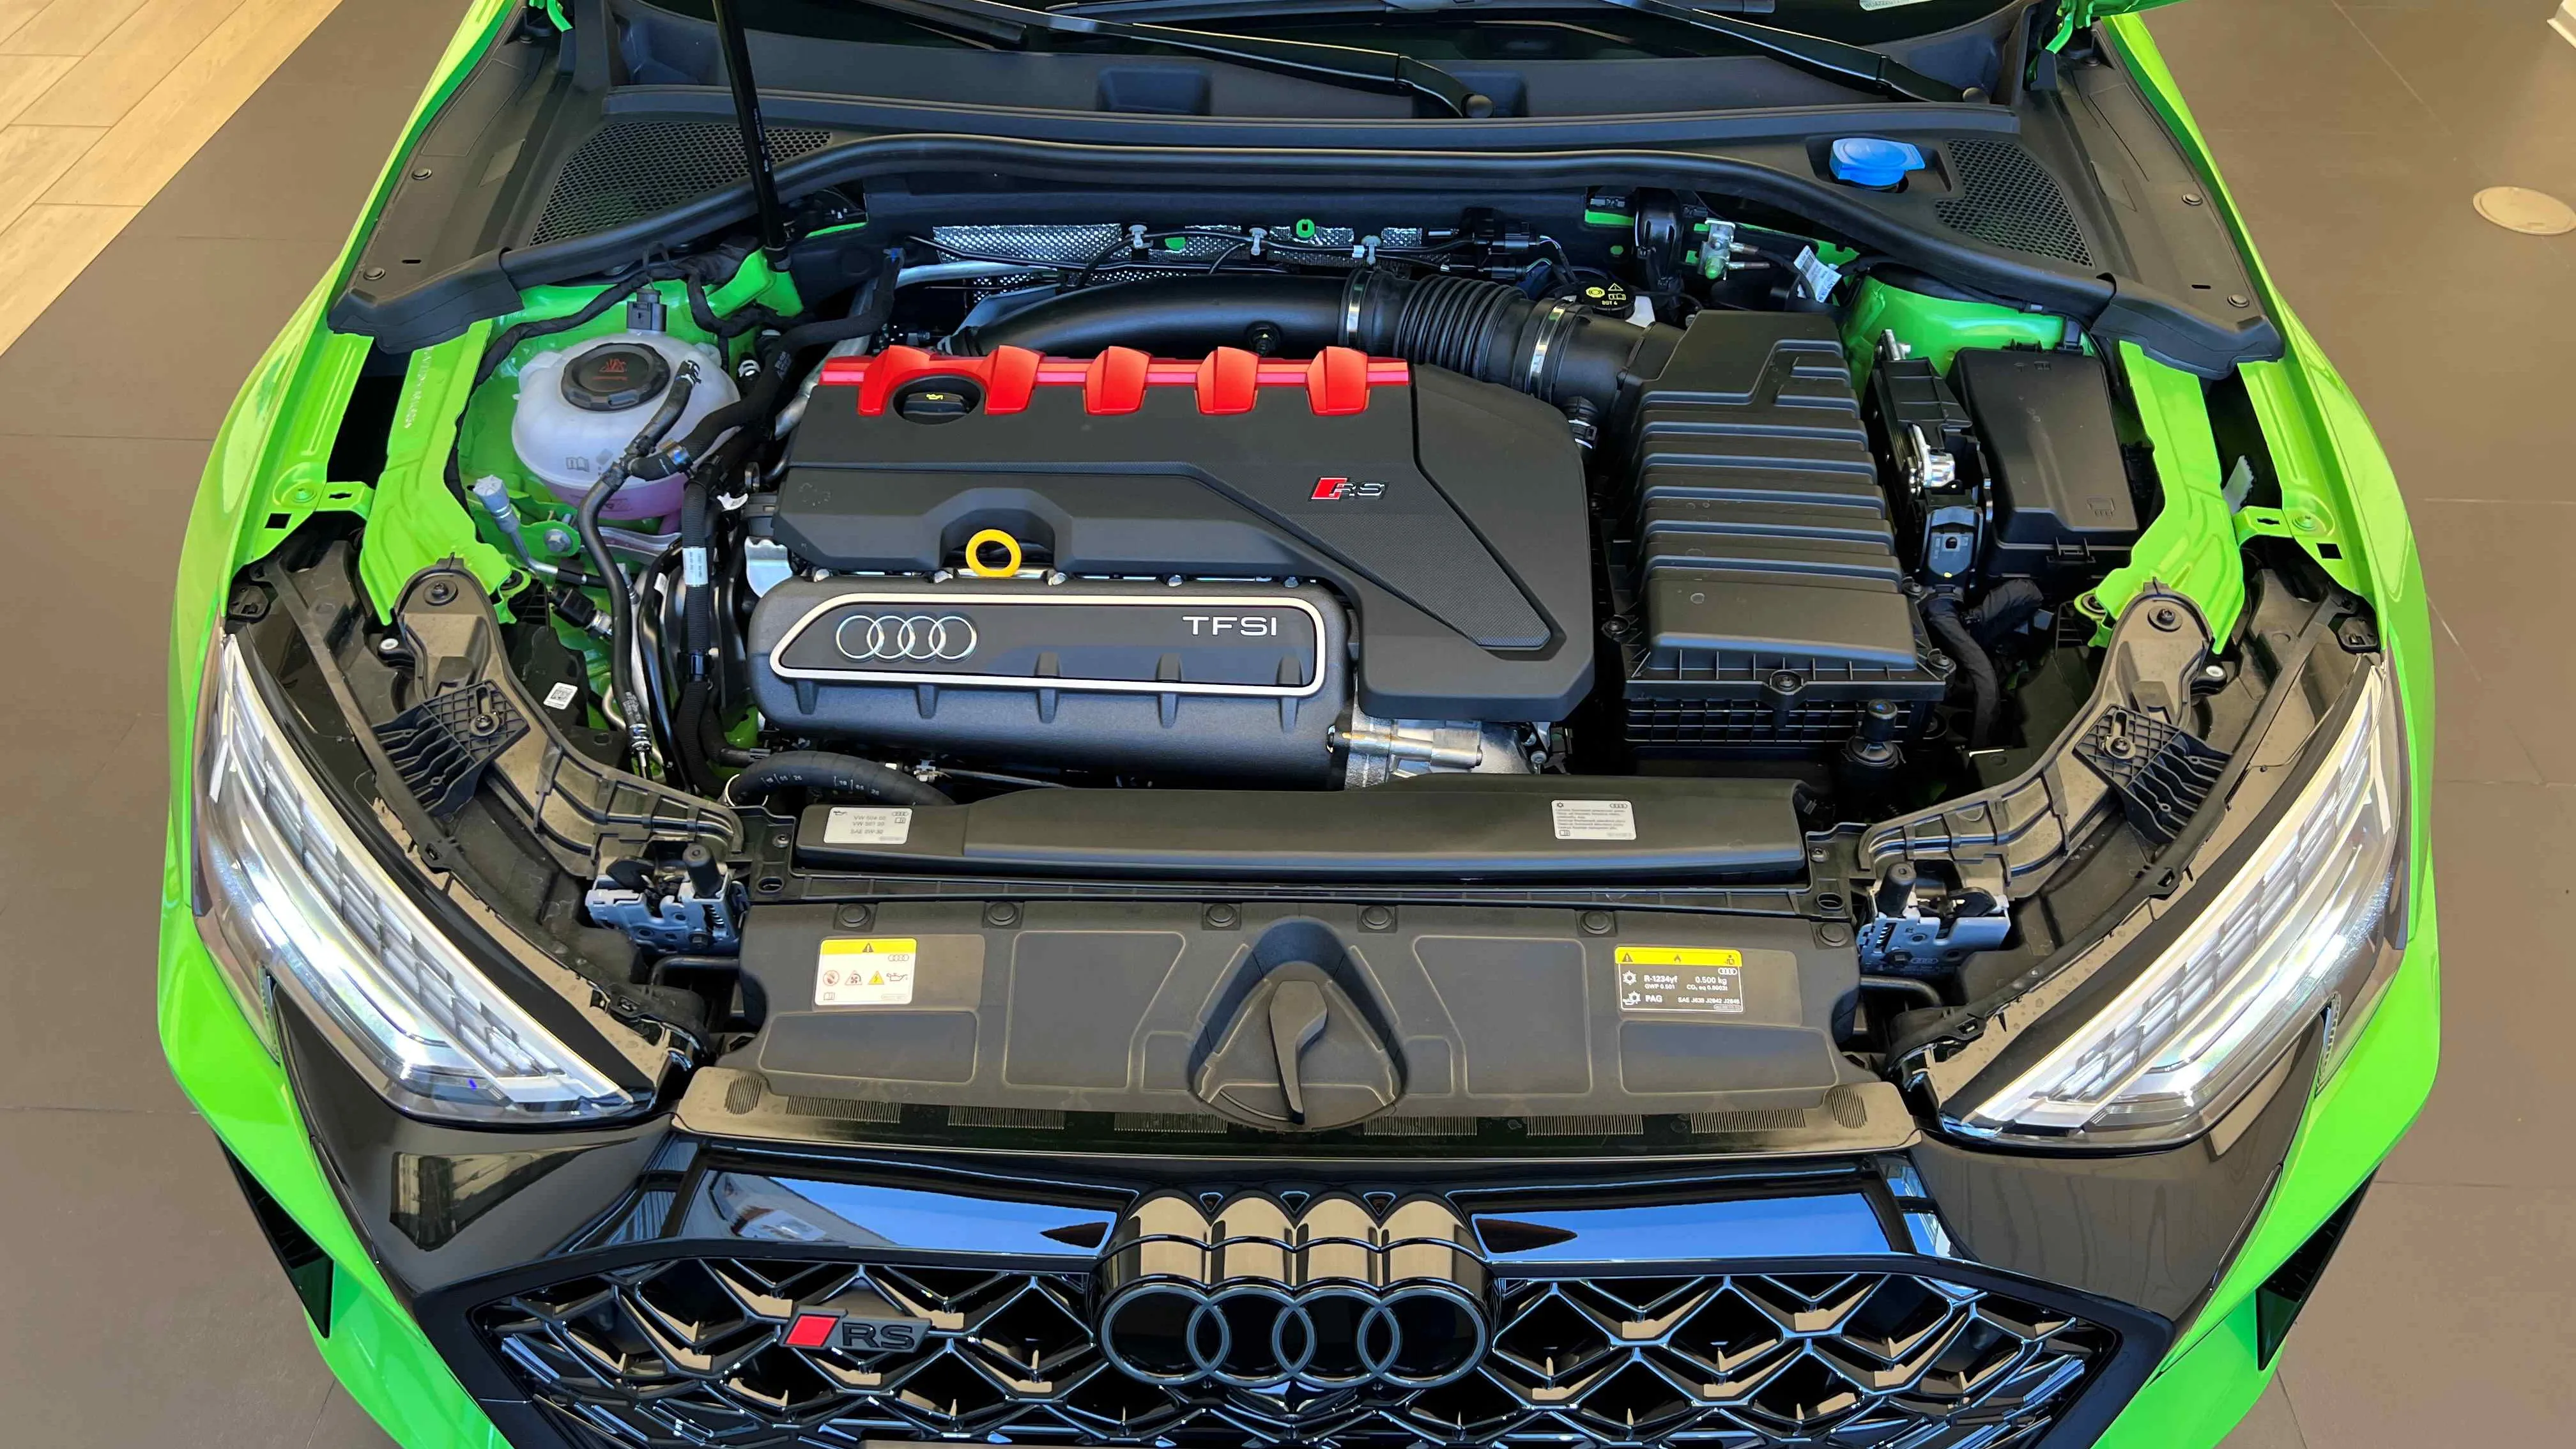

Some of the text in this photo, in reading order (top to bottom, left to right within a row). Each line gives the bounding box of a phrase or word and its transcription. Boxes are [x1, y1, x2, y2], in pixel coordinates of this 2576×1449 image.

[1329, 482, 1385, 498] RS
[1182, 616, 1277, 636] TFSI
[1644, 975, 1728, 985] R-1234yf 0.500 kg
[1645, 994, 1662, 1002] PAG
[841, 1322, 915, 1350] RS
